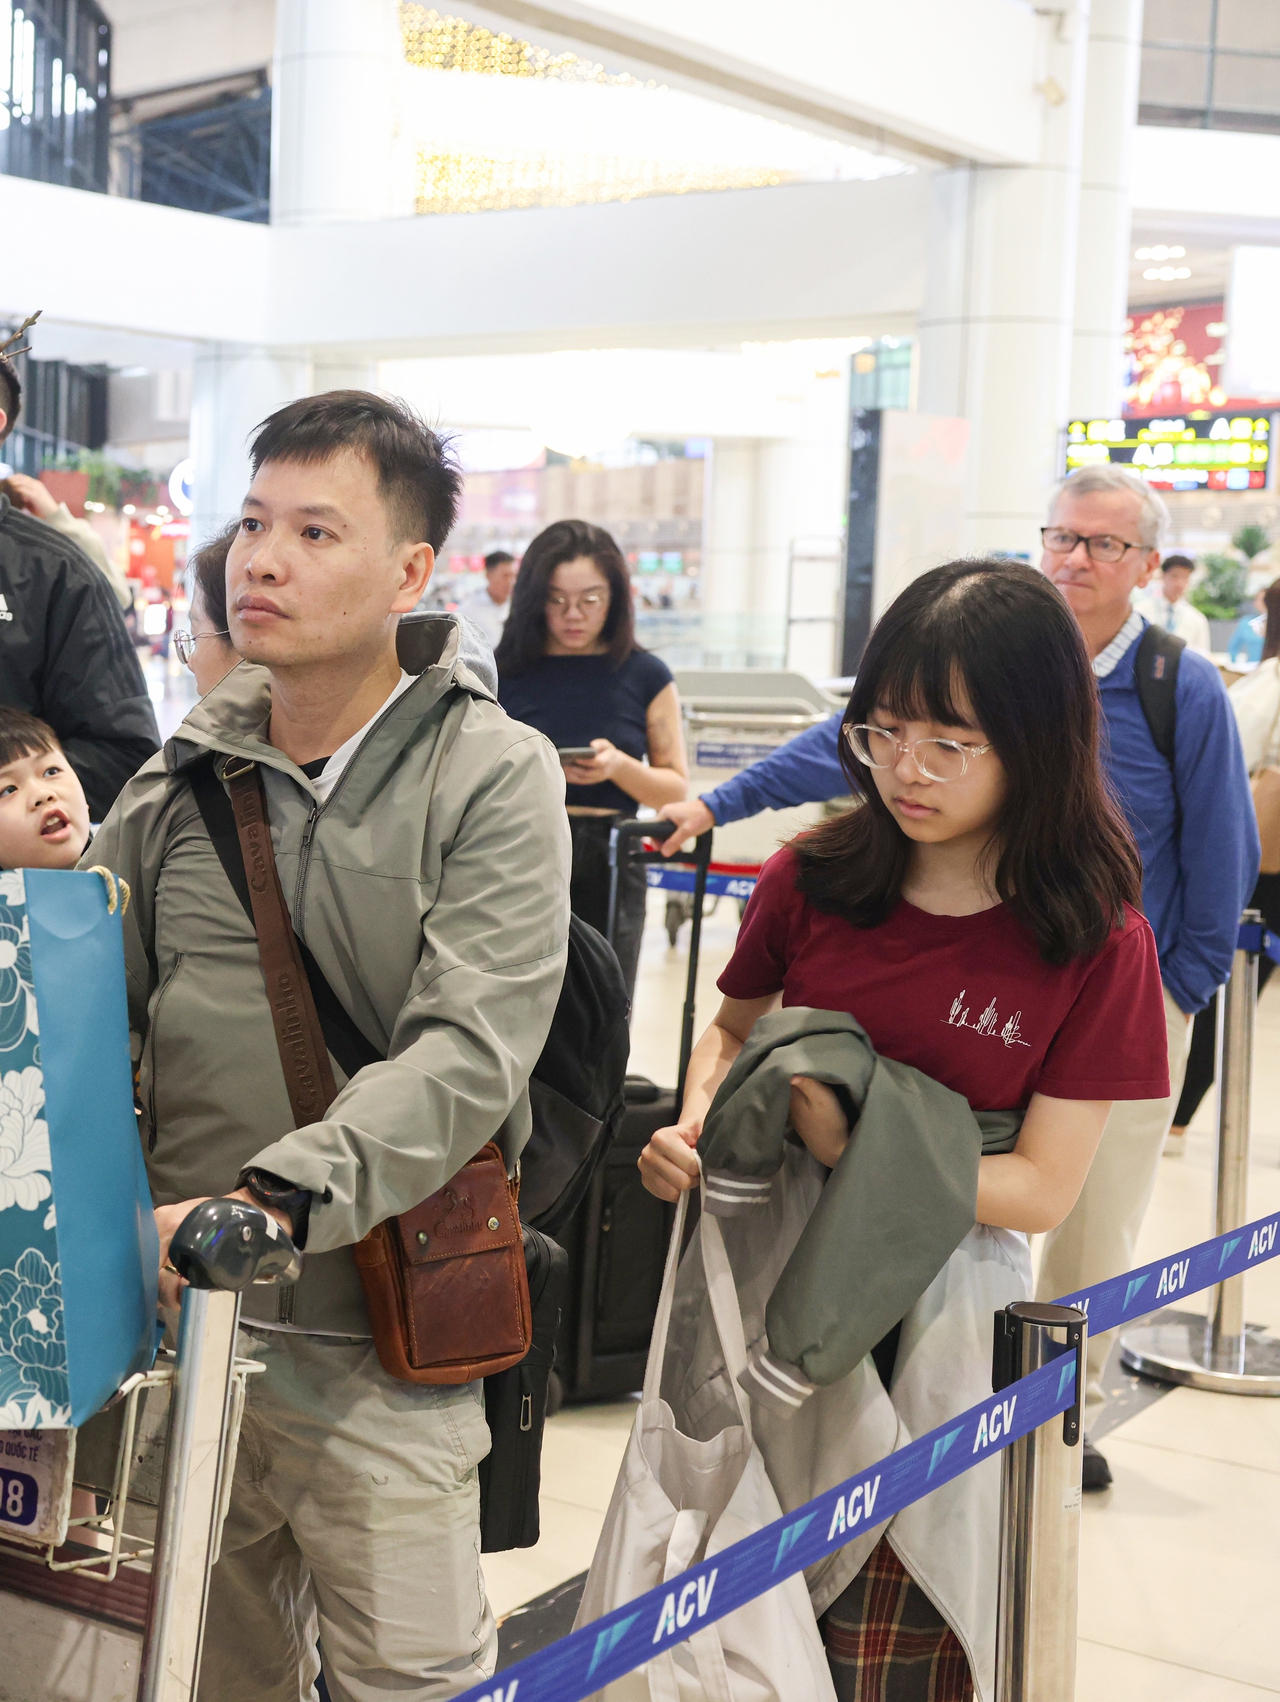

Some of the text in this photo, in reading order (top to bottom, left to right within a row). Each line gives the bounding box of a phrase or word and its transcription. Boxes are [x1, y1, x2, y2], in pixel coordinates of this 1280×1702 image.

[1248, 1222, 1278, 1259] ACV
[1156, 1258, 1190, 1299] ACV
[973, 1395, 1017, 1454] ACV
[827, 1475, 881, 1541] ACV
[652, 1568, 718, 1644] ACV
